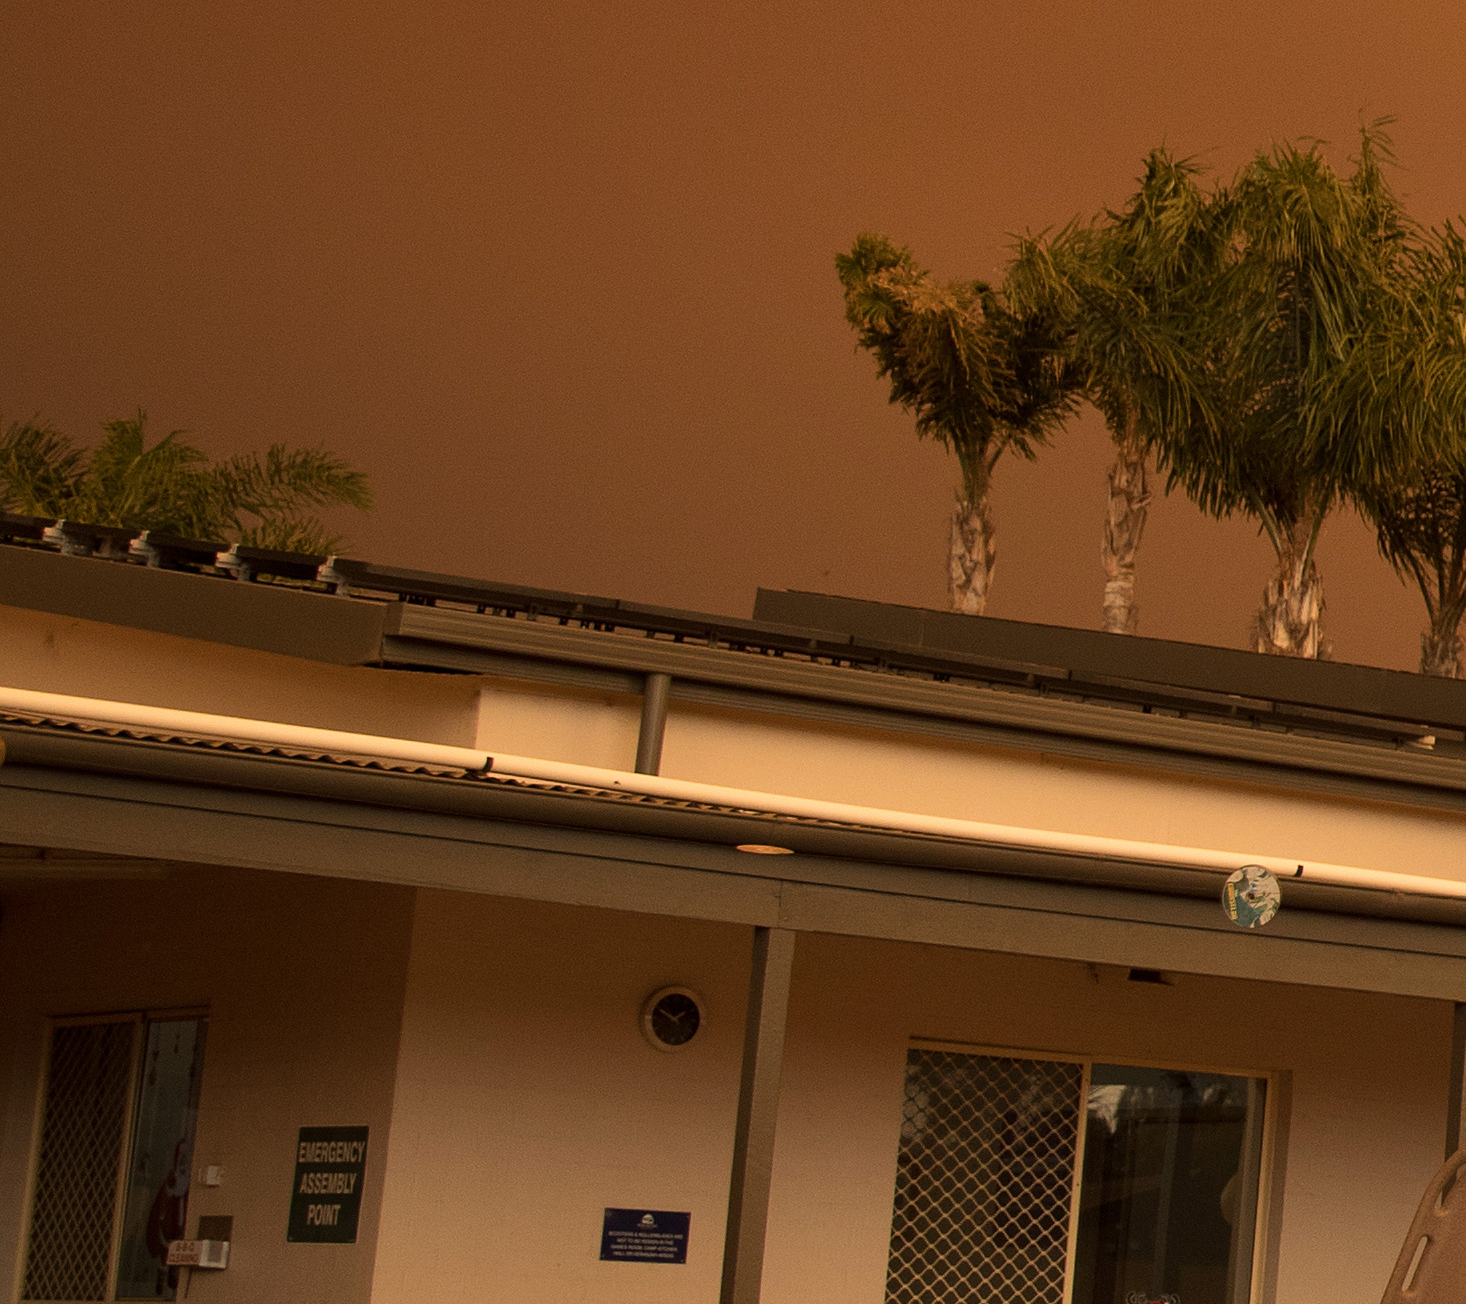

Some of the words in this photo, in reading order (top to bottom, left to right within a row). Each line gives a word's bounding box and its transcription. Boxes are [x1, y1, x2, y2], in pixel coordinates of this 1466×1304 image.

[298, 1140, 366, 1163] EMERGENCY
[299, 1172, 357, 1194] ASSEMBLY
[306, 1203, 342, 1225] POINT
